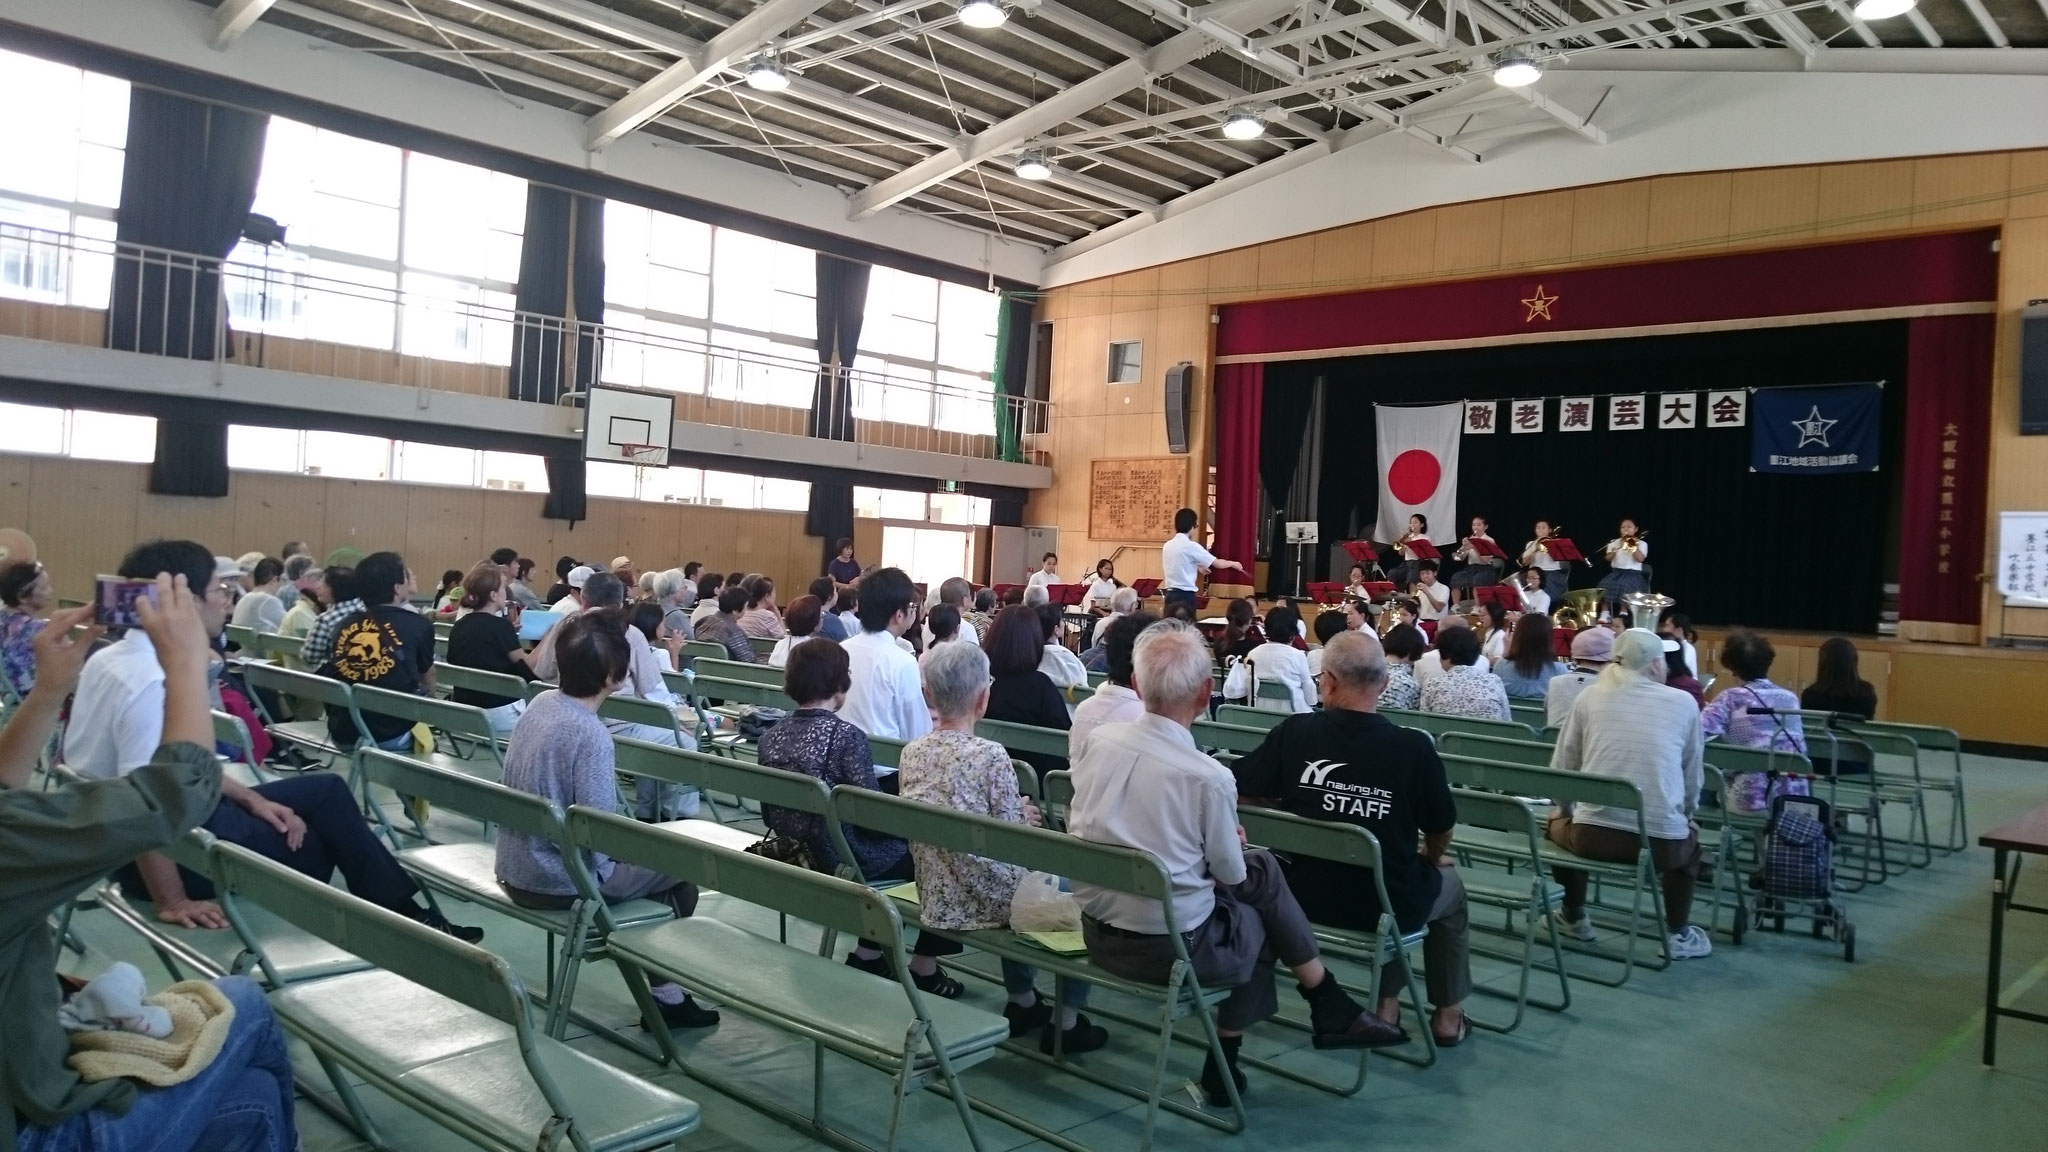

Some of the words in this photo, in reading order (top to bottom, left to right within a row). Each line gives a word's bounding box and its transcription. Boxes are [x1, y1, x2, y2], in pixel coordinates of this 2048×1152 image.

[1468, 395, 1742, 430] 敬老演芸大会
[364, 656, 395, 681] 1983
[1326, 780, 1393, 799] naving.inc
[1322, 793, 1392, 820] STAFF
